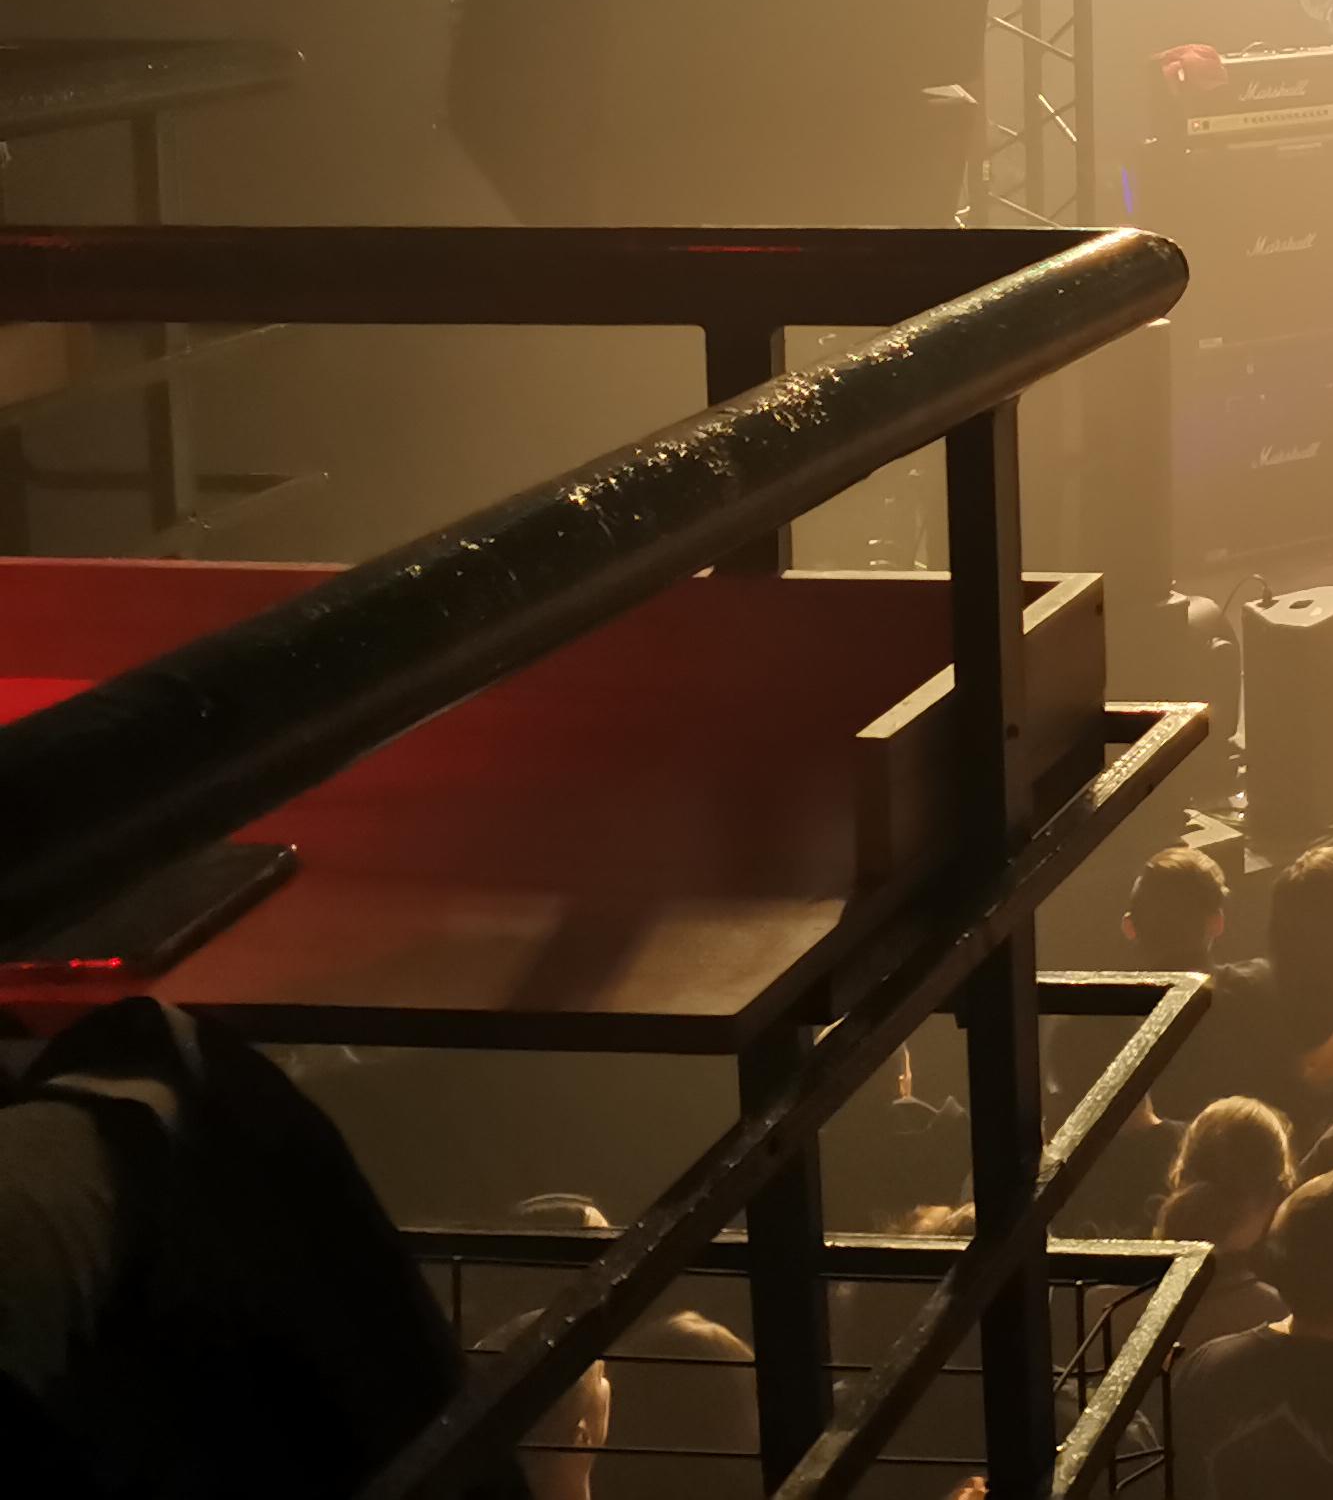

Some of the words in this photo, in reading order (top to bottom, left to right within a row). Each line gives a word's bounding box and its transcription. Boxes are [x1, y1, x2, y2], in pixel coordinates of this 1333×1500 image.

[1238, 78, 1309, 101] Marshall
[1246, 231, 1317, 258] Marshall
[1251, 441, 1322, 469] Marshall
